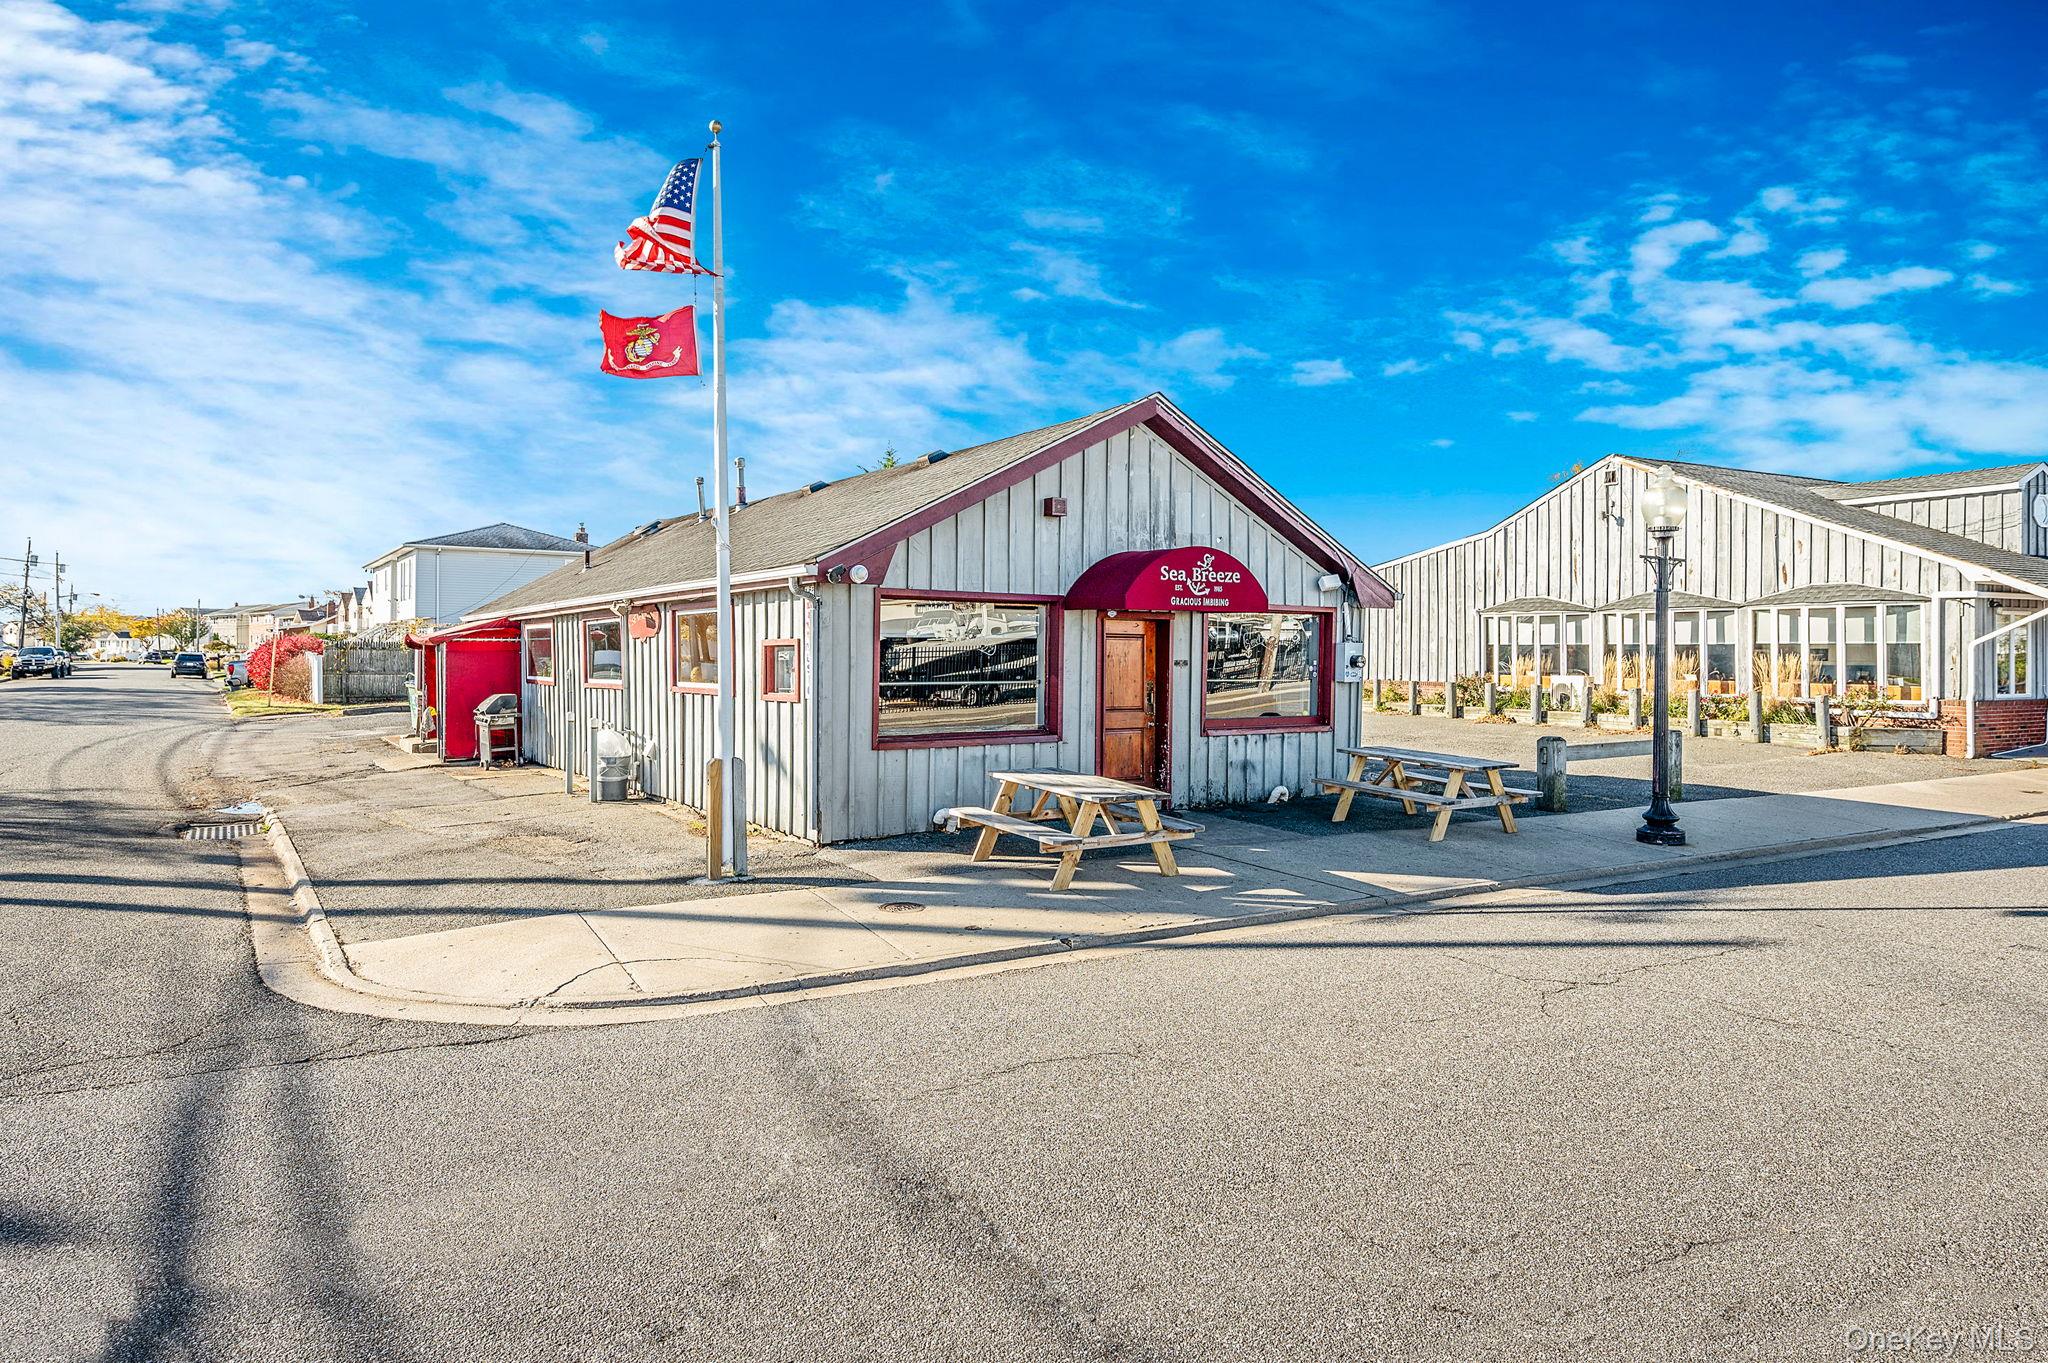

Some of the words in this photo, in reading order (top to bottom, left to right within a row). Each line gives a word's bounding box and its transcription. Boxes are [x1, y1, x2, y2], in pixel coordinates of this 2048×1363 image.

[1160, 565, 1186, 582] Sea
[1192, 567, 1241, 583] Breeze
[1170, 596, 1201, 606] GRACIOUS
[1203, 597, 1229, 607] IMBIBING
